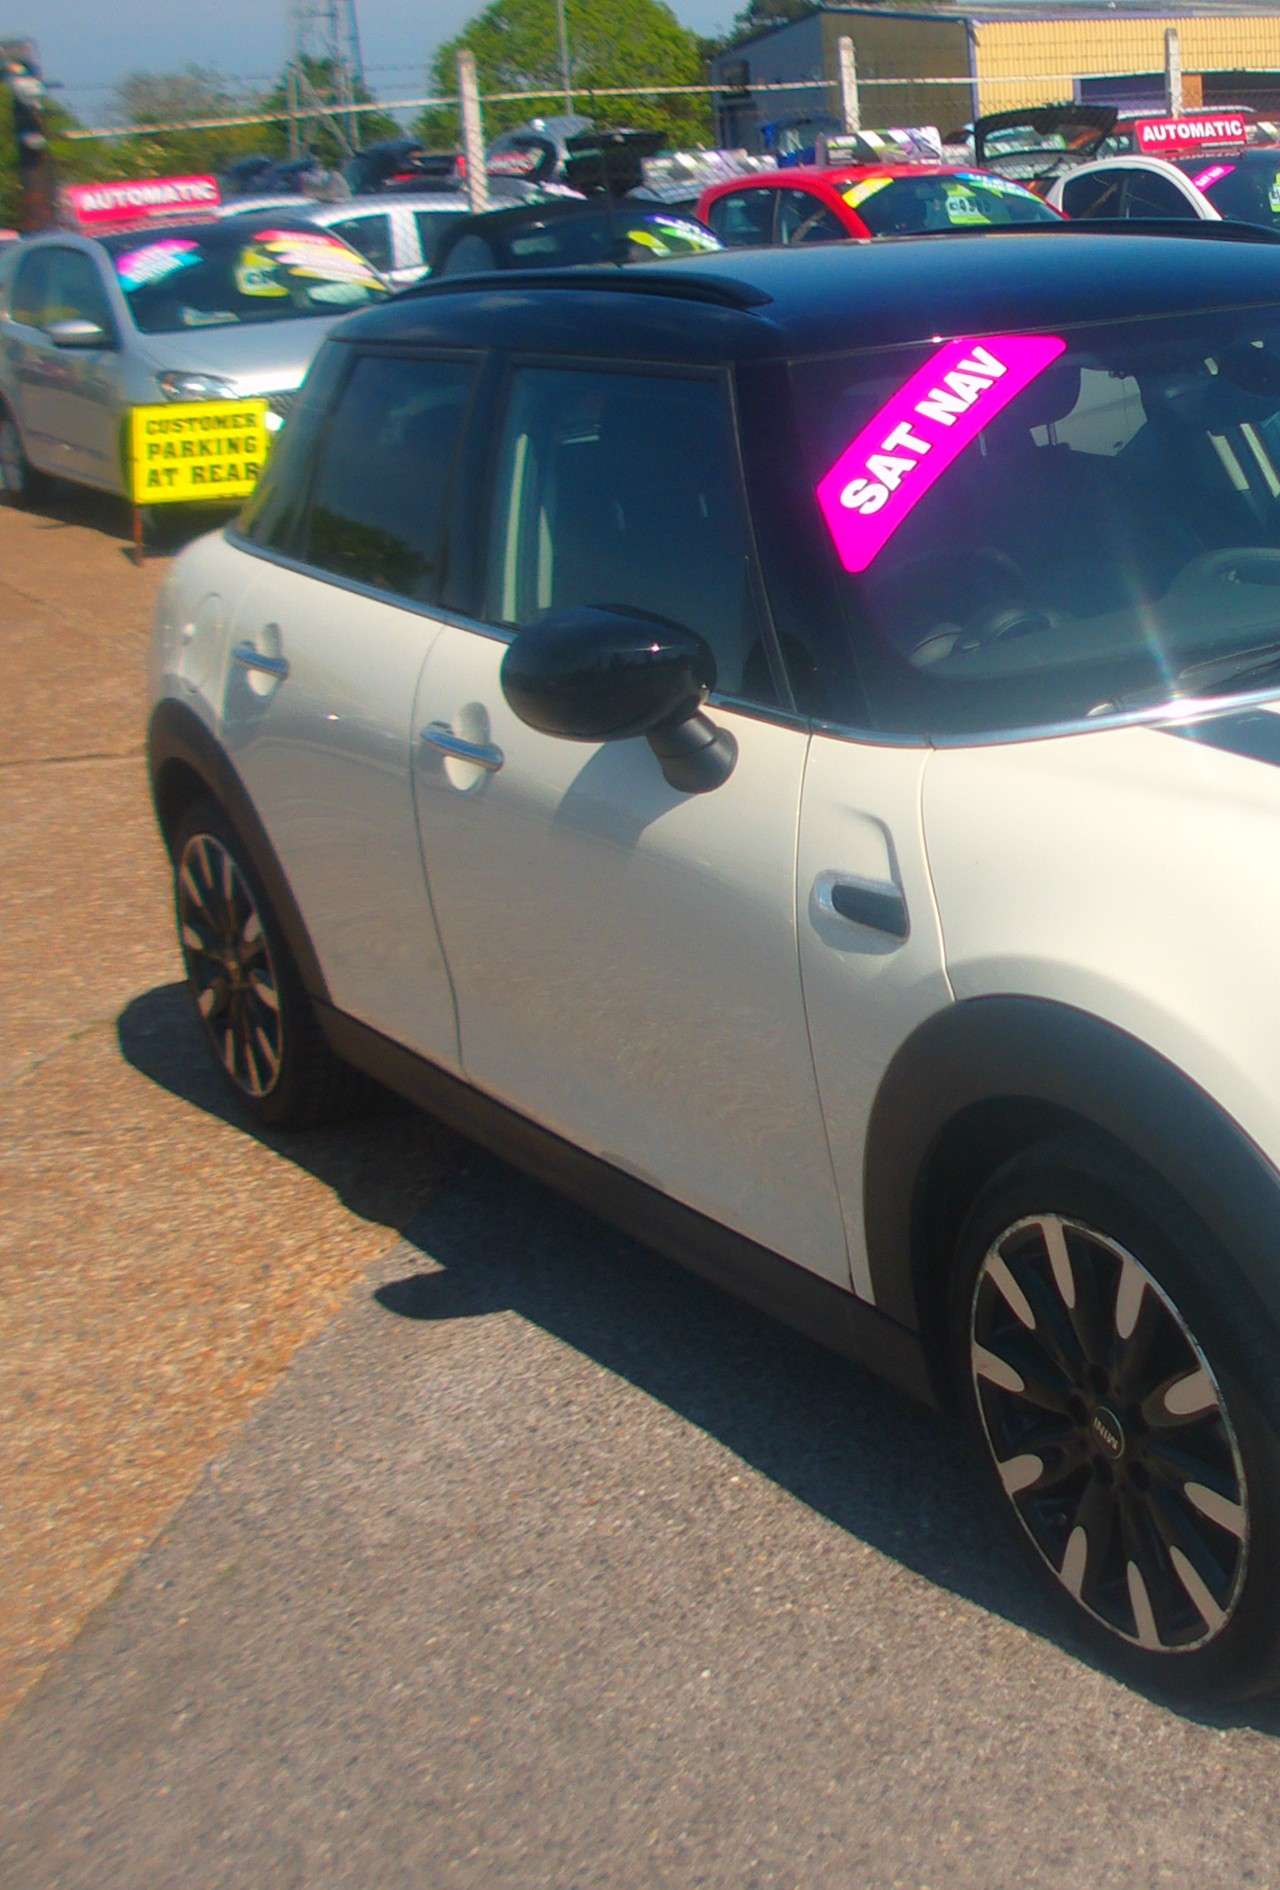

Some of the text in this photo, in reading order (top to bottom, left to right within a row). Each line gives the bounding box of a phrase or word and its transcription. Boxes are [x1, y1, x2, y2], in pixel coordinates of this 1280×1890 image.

[1142, 119, 1243, 142] AUTOMATIC
[80, 181, 218, 210] AUTOMATIC
[145, 412, 257, 435] CUSTOMER
[839, 345, 1008, 516] SAT NAV
[147, 435, 257, 460] PARKING
[147, 461, 259, 488] AT REAR
